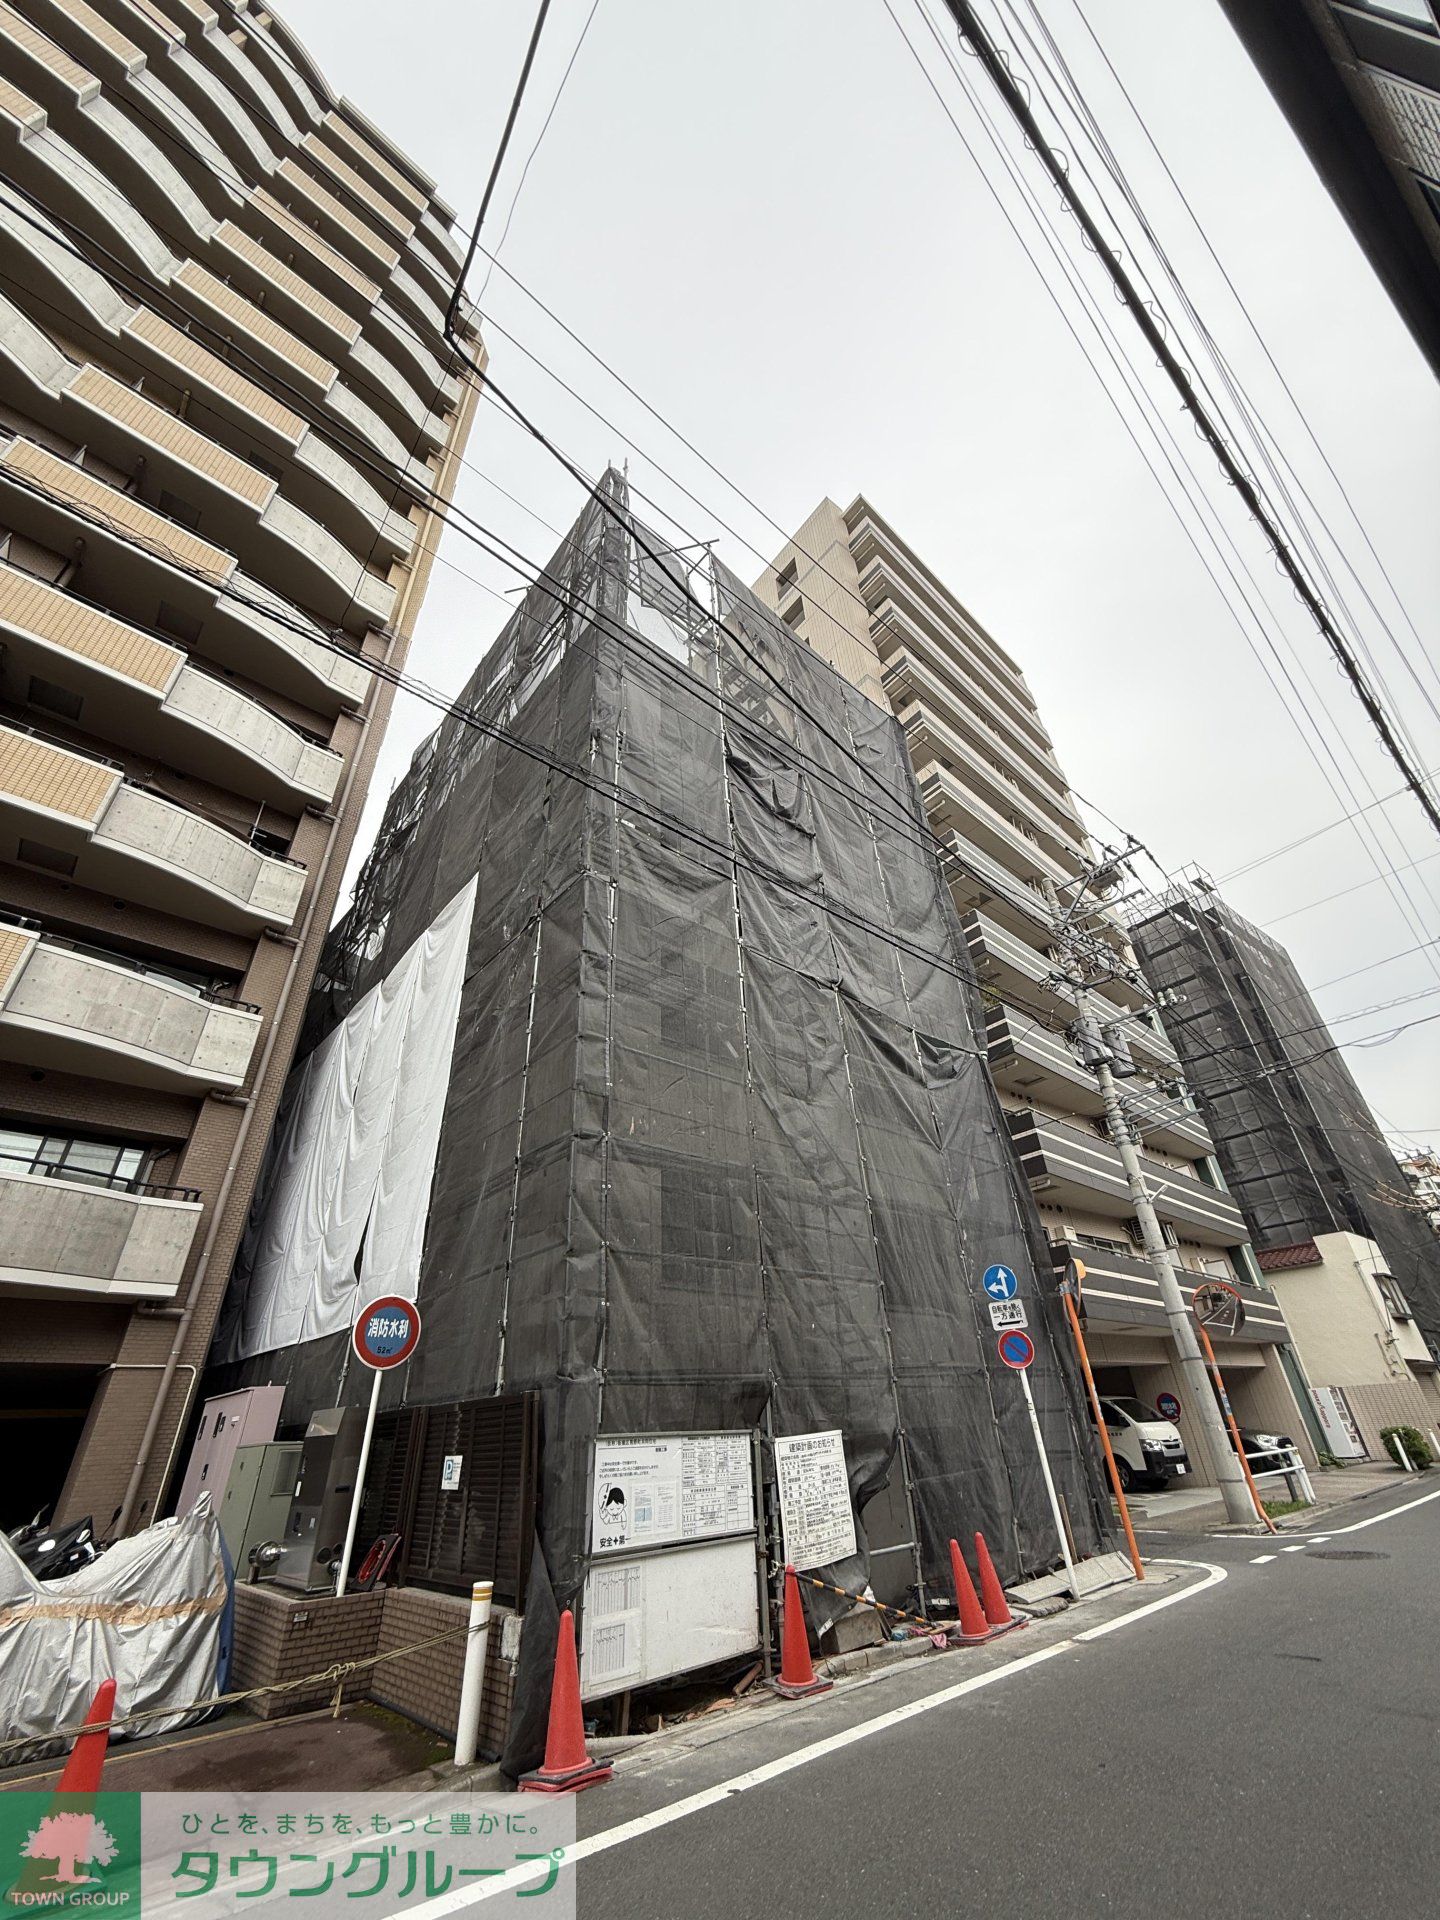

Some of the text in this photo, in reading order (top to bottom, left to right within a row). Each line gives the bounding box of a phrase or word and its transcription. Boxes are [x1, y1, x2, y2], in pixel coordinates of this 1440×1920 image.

[993, 1311, 1023, 1320] 一方通行
[367, 1318, 409, 1338] 消防水利
[789, 1438, 835, 1452] 建築計画のお知らせ
